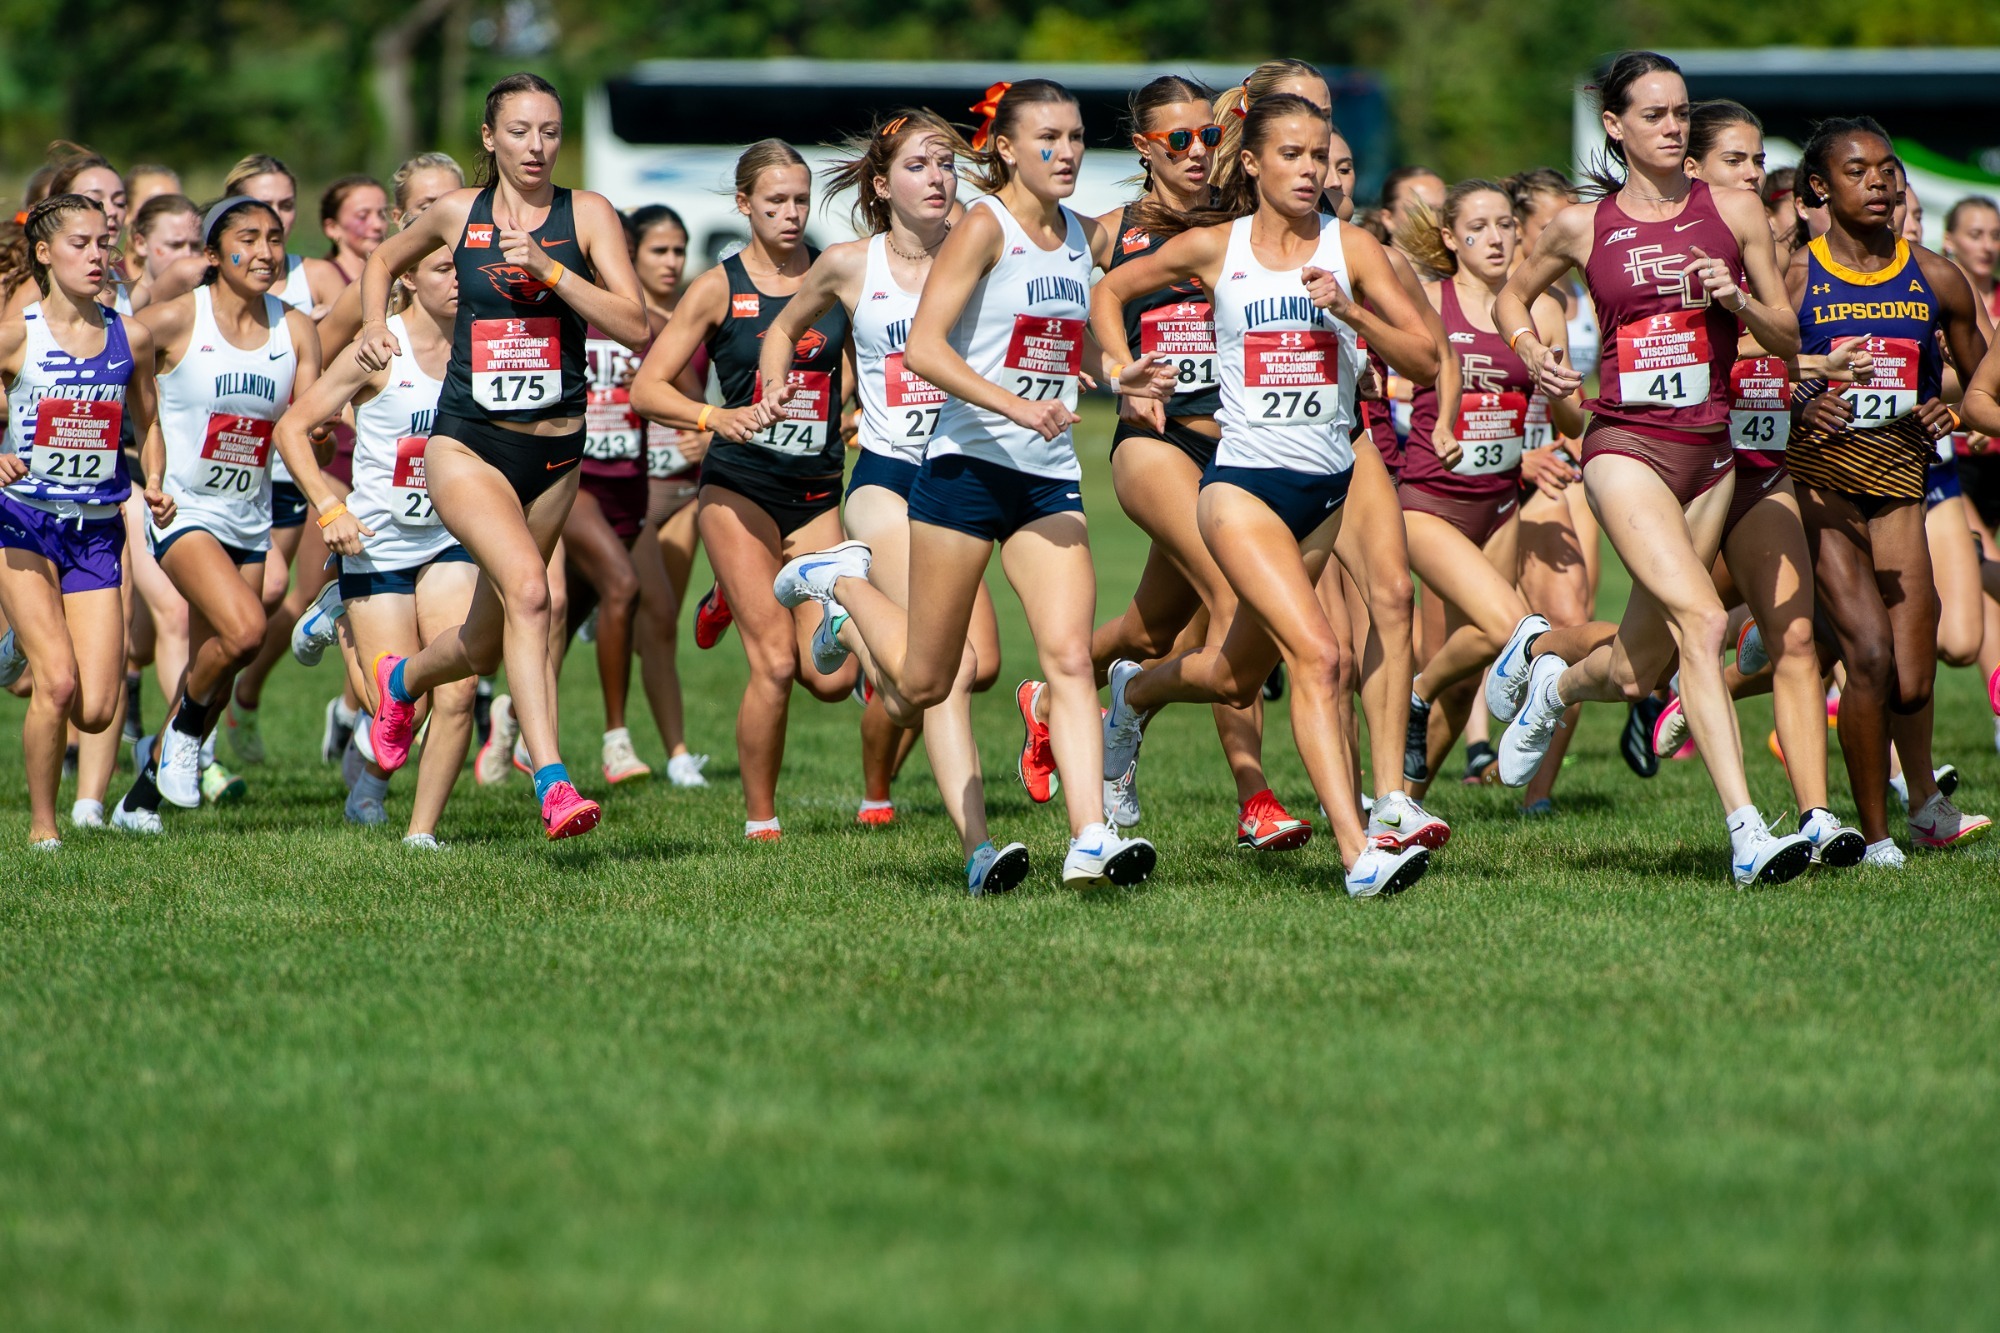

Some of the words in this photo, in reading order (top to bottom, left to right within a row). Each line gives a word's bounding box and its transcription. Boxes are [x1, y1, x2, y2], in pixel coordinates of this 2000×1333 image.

[467, 230, 493, 241] WCC
[1605, 227, 1638, 246] ACC
[1026, 276, 1086, 309] VILLANOVA
[732, 300, 760, 311] WCC
[1244, 296, 1325, 329] VILLANOVA
[1813, 301, 1930, 325] LIPSCOMB
[1157, 321, 1215, 331] NUTTYCOMB
[1023, 336, 1075, 351] NUTTYCOMBE
[1163, 331, 1212, 341] WISCONSIN
[1449, 332, 1476, 344] ACC
[1633, 331, 1695, 348] NUTTYCOMBE
[487, 338, 549, 350] NUTTYCOMBE
[1156, 341, 1217, 351] INVITATIONA
[1640, 343, 1688, 358] WISCONSIN
[493, 348, 541, 359] WISCONSIN
[1027, 347, 1067, 361] WISCONSIN
[1260, 351, 1325, 362] NUTTYCOMBE
[487, 358, 550, 370] INVITATIONAL
[1018, 357, 1070, 372] INVITATIONAL
[1266, 362, 1317, 373] WISCONSIN
[1634, 356, 1698, 370] INVITATIONAL
[1873, 357, 1907, 368] YCOMBE
[1163, 358, 1215, 384] 81
[1260, 372, 1325, 384] INVITATIONAL
[215, 372, 276, 403] VILLANOVA
[490, 375, 545, 402] 175
[1015, 376, 1065, 401] 277
[1648, 372, 1686, 400] 41
[1739, 378, 1785, 388] NUTTYCOMBE
[901, 390, 948, 403] INVITATIO
[1743, 388, 1779, 398] WISCONSIN
[1262, 391, 1321, 418] 276
[1735, 398, 1785, 409] INVITATIONAL
[1846, 393, 1898, 419] 121
[51, 416, 110, 429] NUTTYCOMBE
[905, 408, 941, 437] 27
[1742, 416, 1775, 442] 43
[56, 427, 101, 438] WISCONSIN
[217, 431, 265, 447] NUTTYCOMBE
[764, 423, 813, 448] 174
[48, 436, 108, 449] INVITATIONAL
[220, 441, 256, 454] WISCONSIN
[211, 449, 259, 465] INVITATIONAL
[1474, 444, 1504, 467] 33
[46, 452, 102, 479] 212
[205, 465, 252, 493] 270
[405, 493, 436, 518] 27
